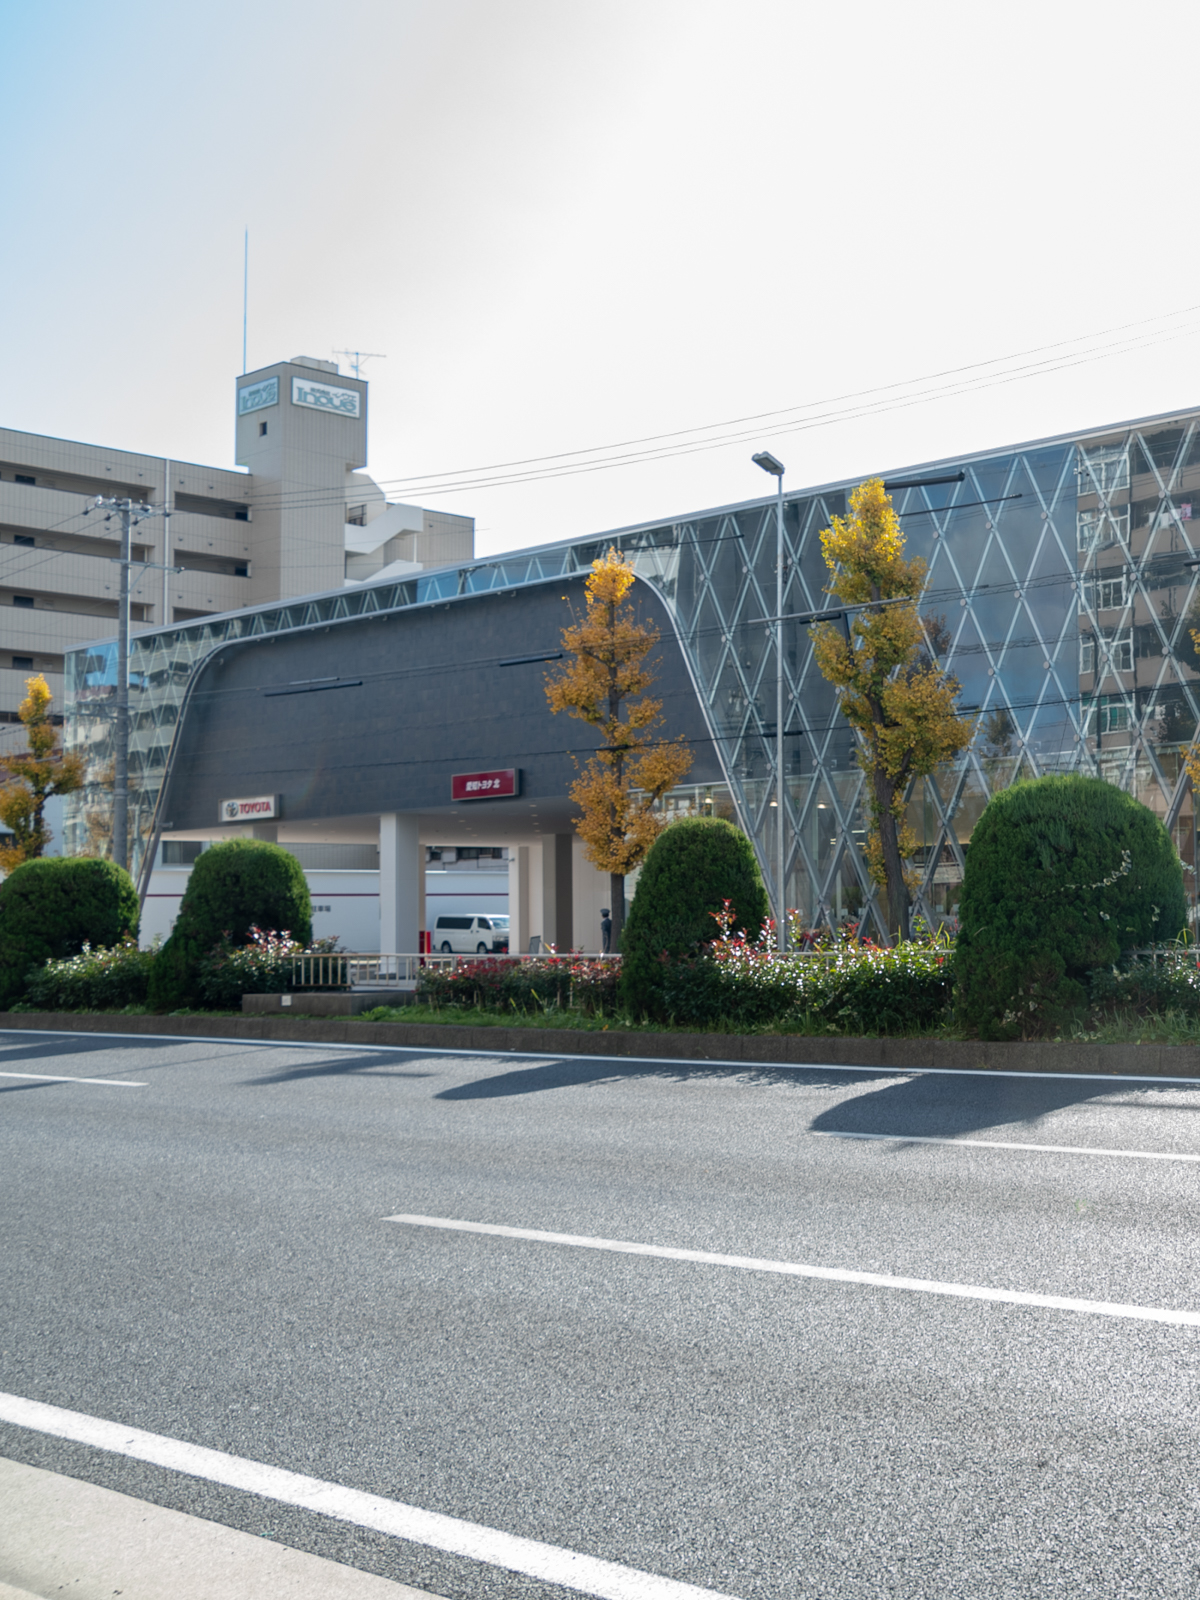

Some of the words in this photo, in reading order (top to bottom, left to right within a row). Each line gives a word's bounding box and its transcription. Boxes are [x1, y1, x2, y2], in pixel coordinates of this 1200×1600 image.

[240, 390, 276, 411] Inoue
[296, 386, 357, 415] Inoue
[239, 801, 271, 814] TOYOTA
